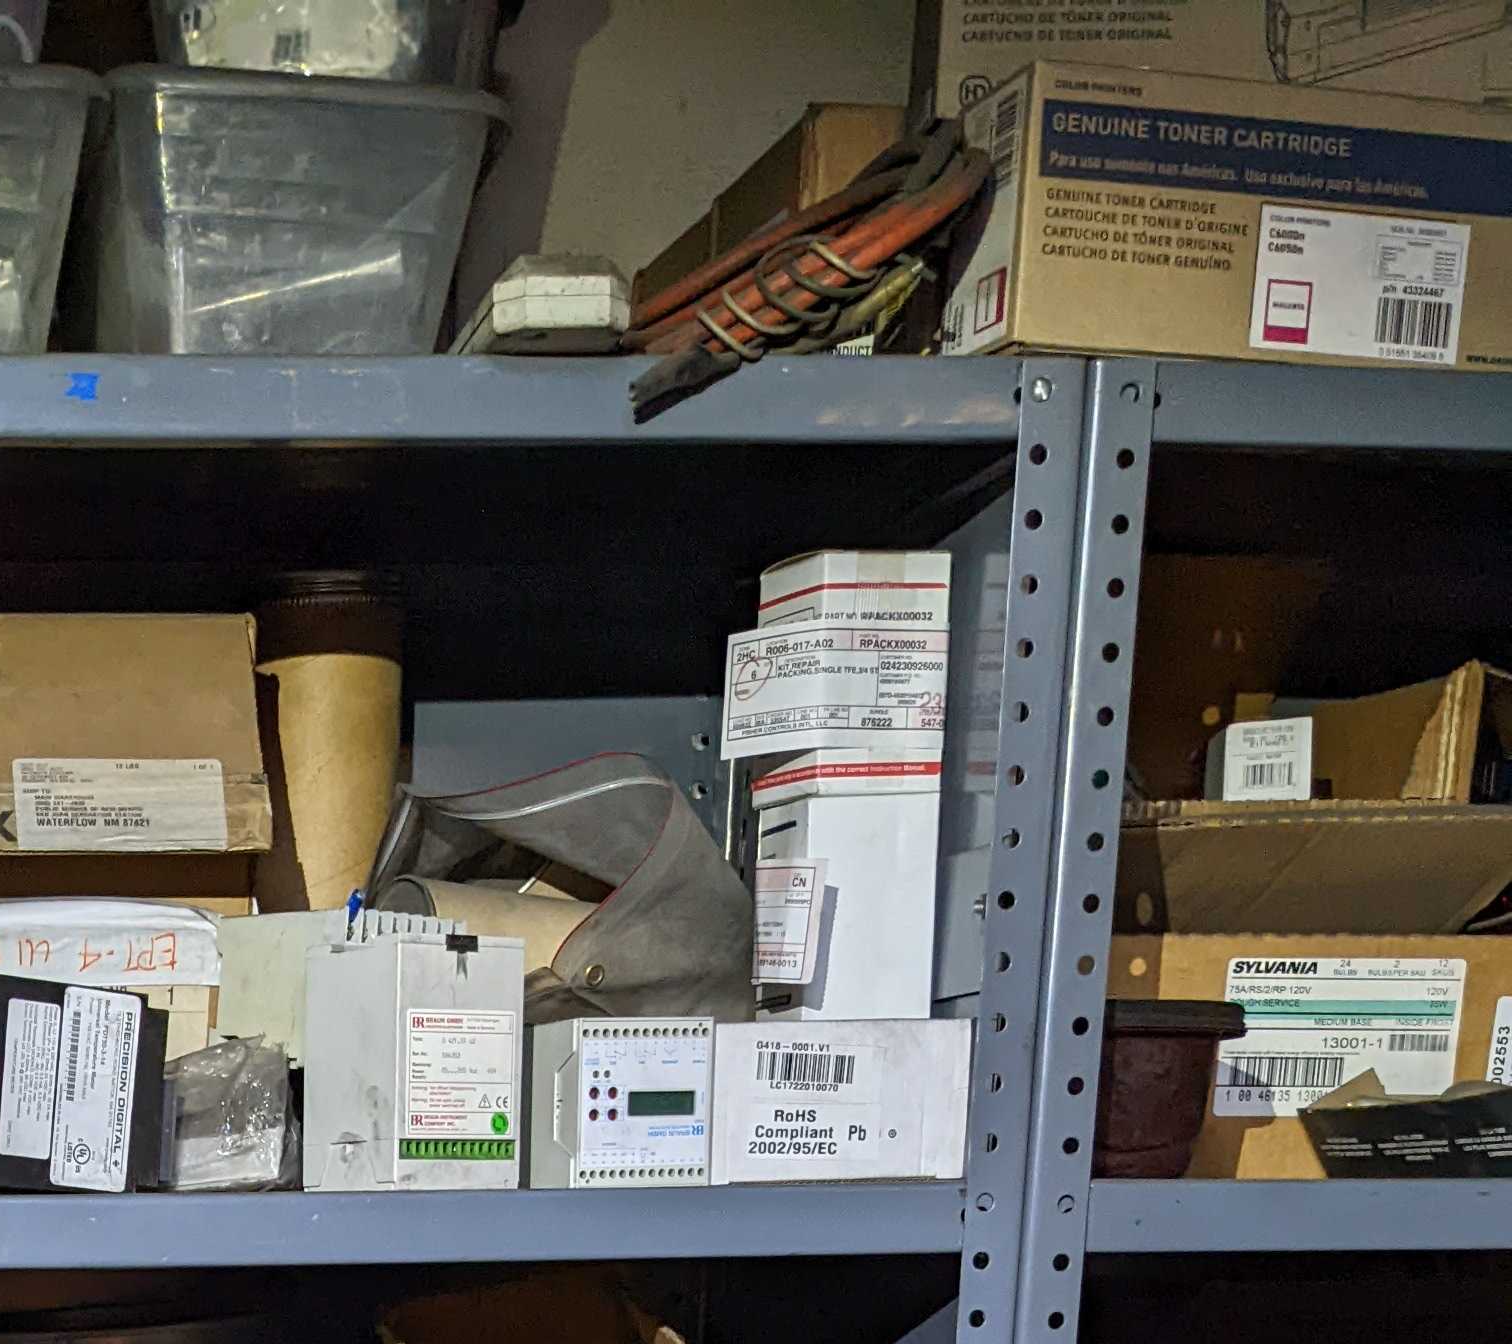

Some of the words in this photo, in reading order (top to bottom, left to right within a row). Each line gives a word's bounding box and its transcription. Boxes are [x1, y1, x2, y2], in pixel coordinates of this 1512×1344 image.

[1052, 112, 1150, 139] GENUINE
[1157, 121, 1225, 146] TONER
[1233, 129, 1353, 157] CARTRIDGE
[1046, 188, 1102, 205] GENUINE
[1105, 193, 1145, 208] TONER
[1150, 199, 1216, 214] CARTRIDGE
[1045, 207, 1118, 224] CARTOUCHE
[1123, 213, 1137, 226] DE
[1043, 226, 1109, 242] CARTUCHO
[1113, 231, 1129, 244] DE
[1176, 236, 1235, 253] ORIGINAL
[1042, 243, 1106, 260] CARTUCHO
[1112, 249, 1127, 262] DE
[736, 650, 756, 662] 2HC
[860, 639, 927, 649] RPACKX00032
[751, 671, 756, 680] 6
[861, 718, 892, 727] 876222
[36, 818, 98, 828] WATERFLOW
[104, 818, 120, 828] NM
[792, 878, 806, 888] CN
[1232, 960, 1318, 975] SYLVANIA
[1340, 960, 1351, 968] 24
[1289, 986, 1312, 994] 120V
[1426, 987, 1448, 996] 120V
[1263, 998, 1300, 1007] SERVICE
[1314, 1018, 1347, 1026] MEDIUM
[1350, 1018, 1373, 1026] BASE
[1321, 1037, 1383, 1049] 13001-1
[119, 1011, 134, 1093] PRECISION
[770, 1081, 838, 1092] LC1722010070
[496, 1096, 508, 1108] CE
[1258, 1090, 1290, 1102] 46135
[774, 1110, 817, 1123] RoHS
[113, 1097, 126, 1154] DIGITAL
[755, 1125, 834, 1140] Compliant
[848, 1125, 866, 1141] Pb
[748, 1142, 838, 1155] 2002/95/EC
